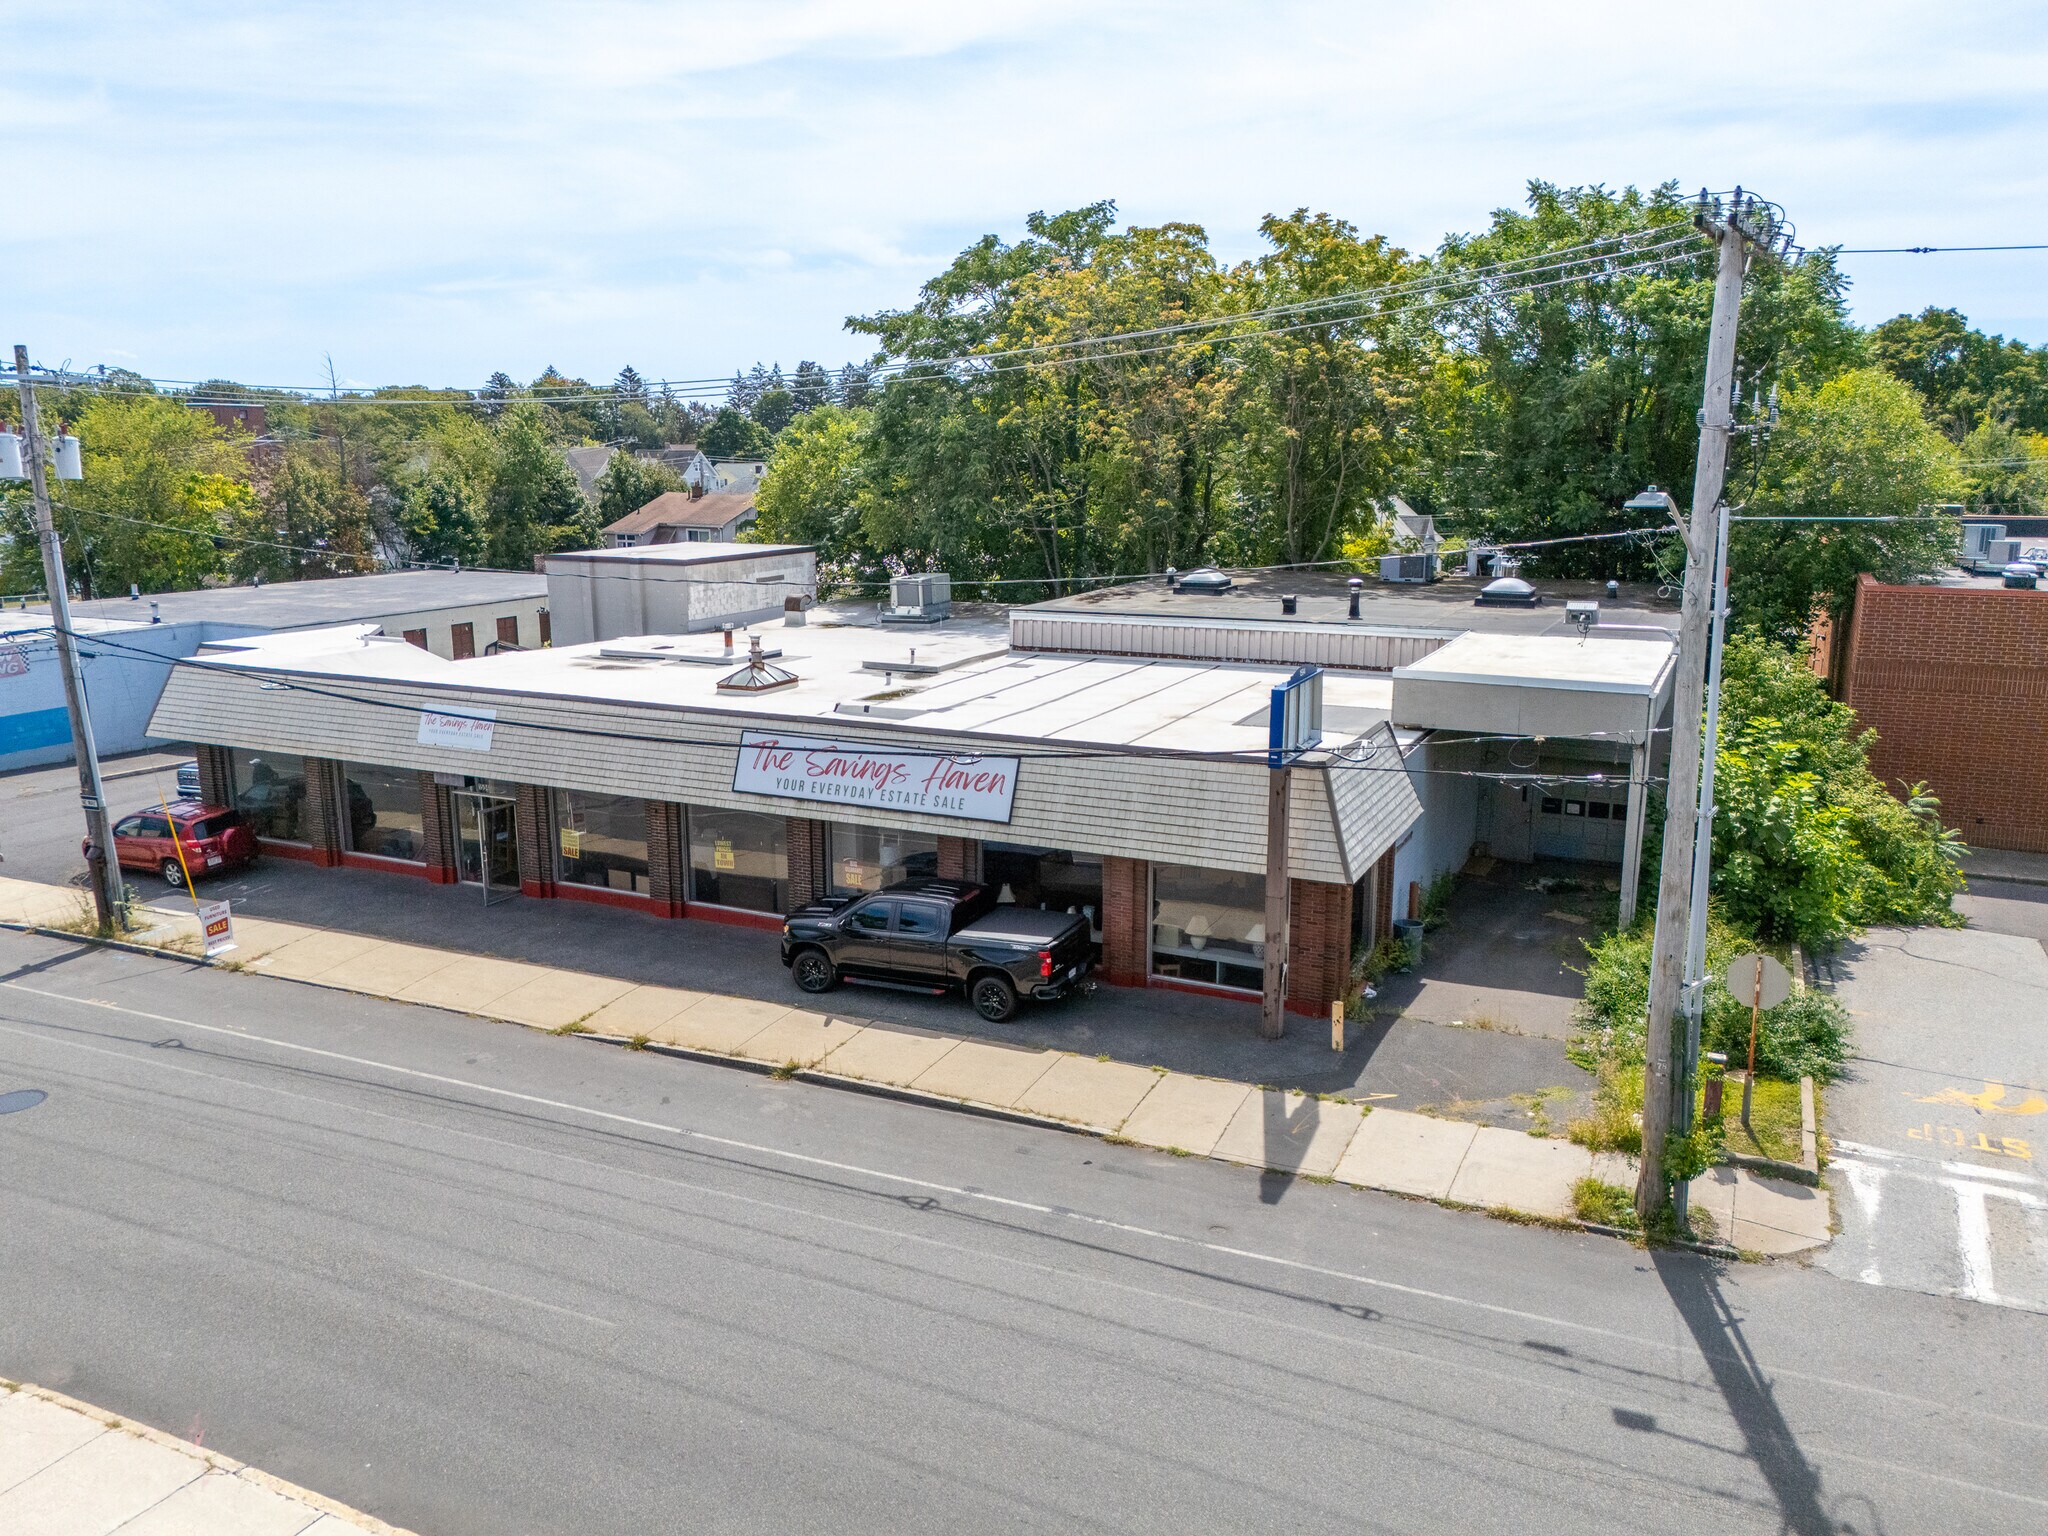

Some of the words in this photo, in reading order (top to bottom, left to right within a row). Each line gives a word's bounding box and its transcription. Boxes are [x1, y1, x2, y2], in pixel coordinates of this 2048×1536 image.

[749, 740, 795, 771] The
[806, 745, 911, 790] Savings
[921, 757, 1006, 795] Haven
[776, 778, 805, 791] YOUR
[811, 781, 874, 799] EVERYDAY
[880, 789, 926, 806] ESTATE
[933, 795, 965, 810] SALE
[563, 846, 578, 857] SALE
[845, 873, 862, 885] SALE
[204, 910, 227, 920] FURNITURE
[208, 920, 228, 934] SALE
[1906, 1123, 2032, 1160] STOP
